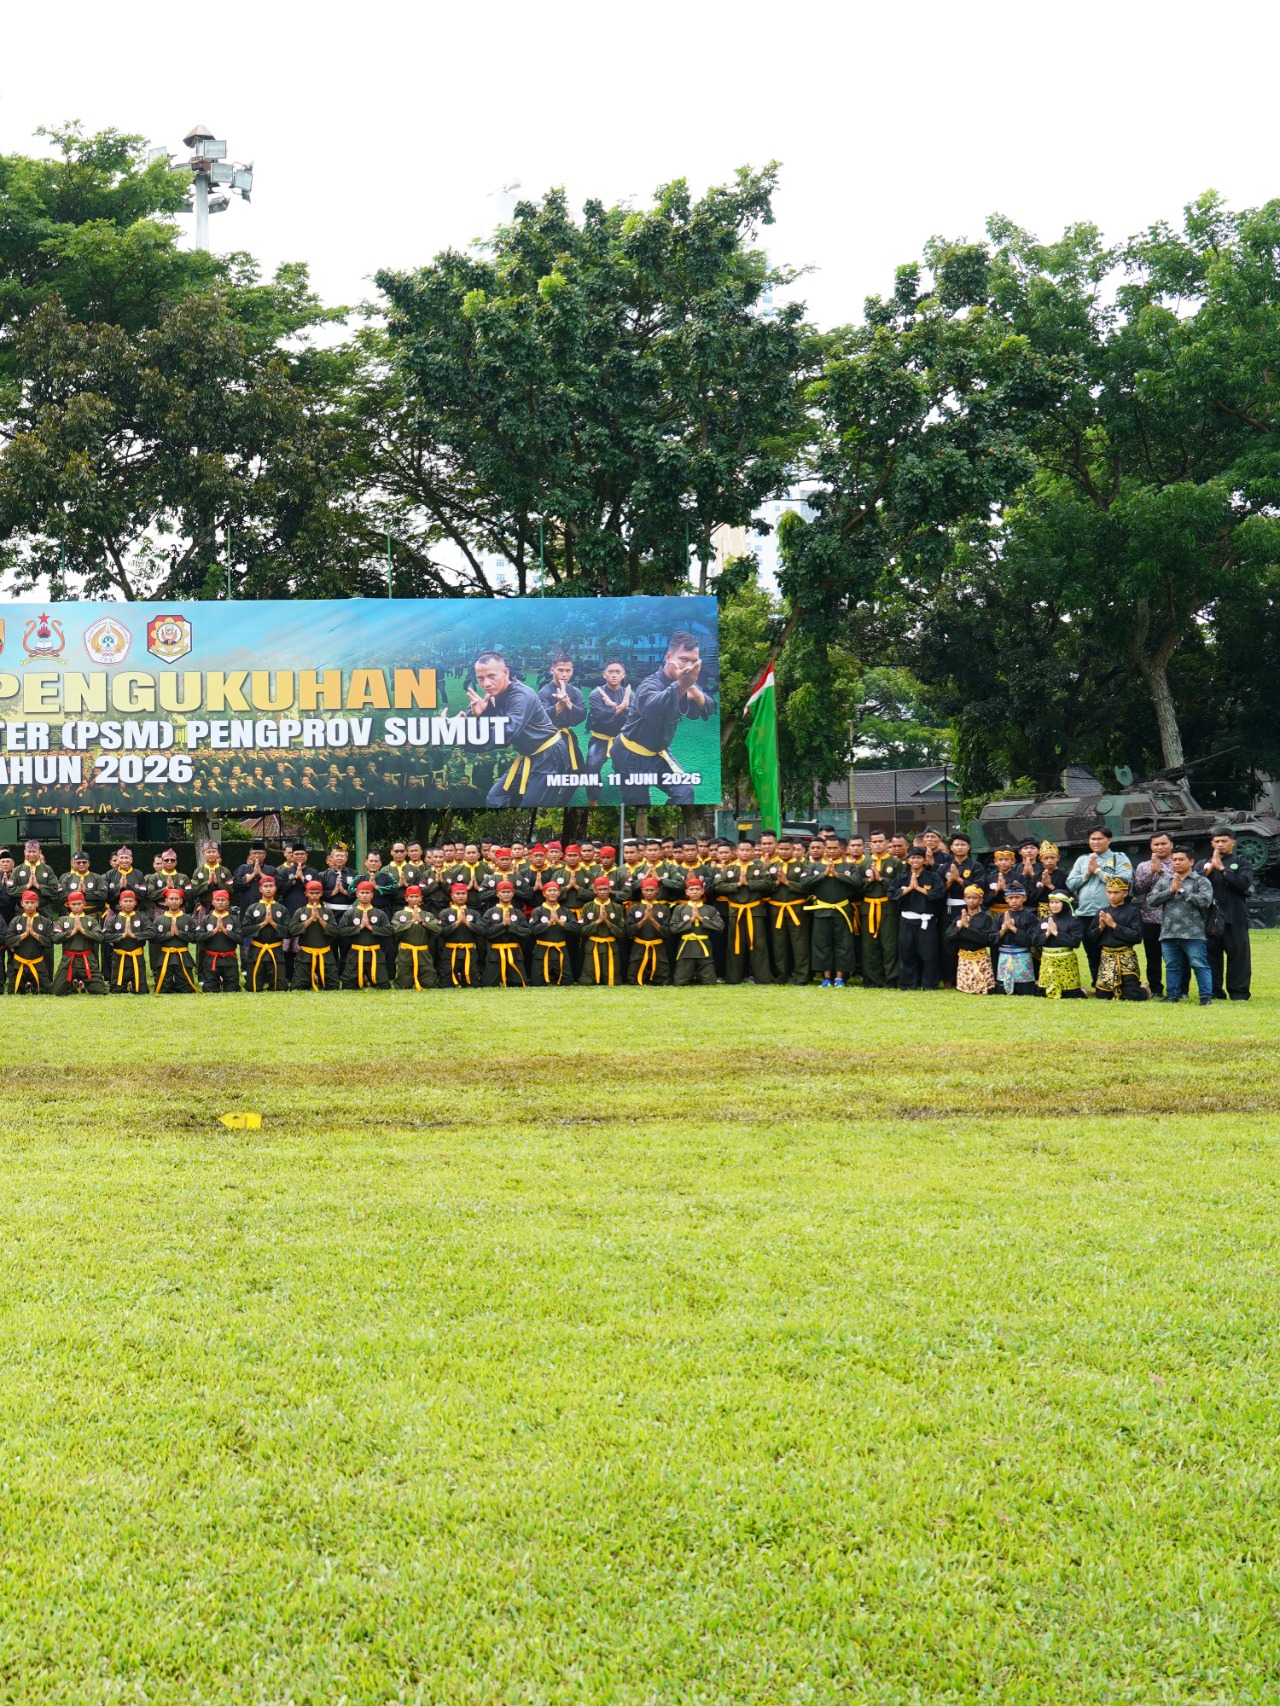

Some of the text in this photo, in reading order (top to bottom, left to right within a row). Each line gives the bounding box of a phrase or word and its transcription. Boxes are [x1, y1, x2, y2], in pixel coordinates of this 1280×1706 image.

[61, 720, 174, 750] (PSM)
[187, 718, 372, 749] PENGPROV
[384, 716, 509, 746] SUMUT
[94, 754, 193, 784] 2026
[546, 772, 701, 787] MEDAN, 11 JUNI 2026
